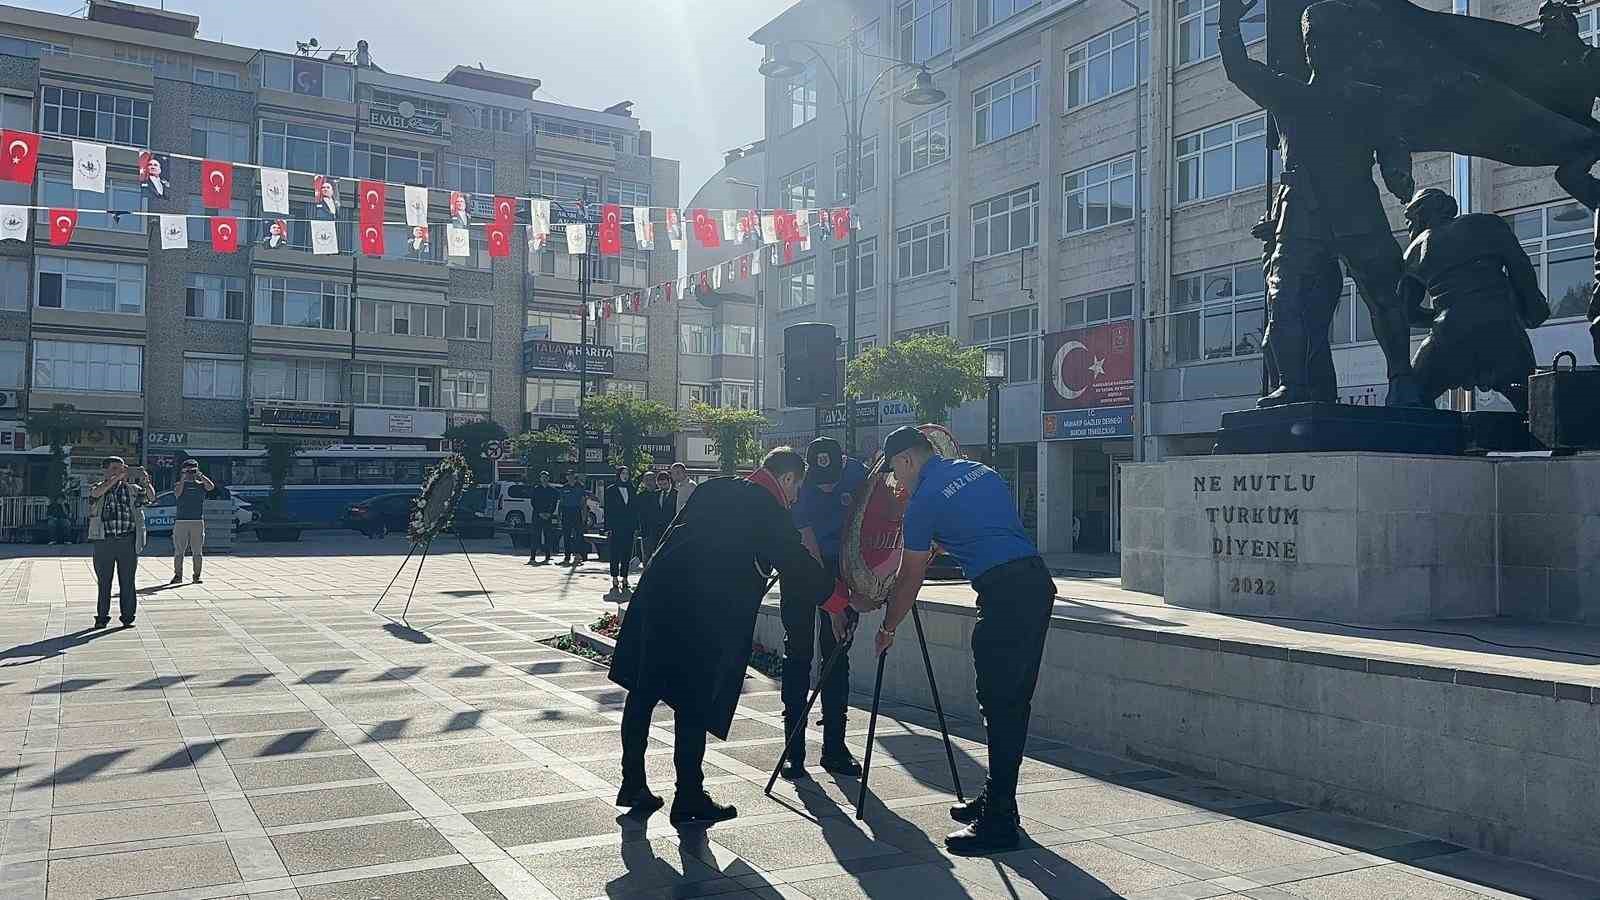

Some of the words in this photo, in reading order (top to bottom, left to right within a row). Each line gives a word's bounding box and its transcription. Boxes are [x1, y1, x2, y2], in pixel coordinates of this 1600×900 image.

[1193, 476, 1221, 492] NE
[1232, 474, 1316, 492] MUTLU
[1231, 577, 1277, 596] 2022
